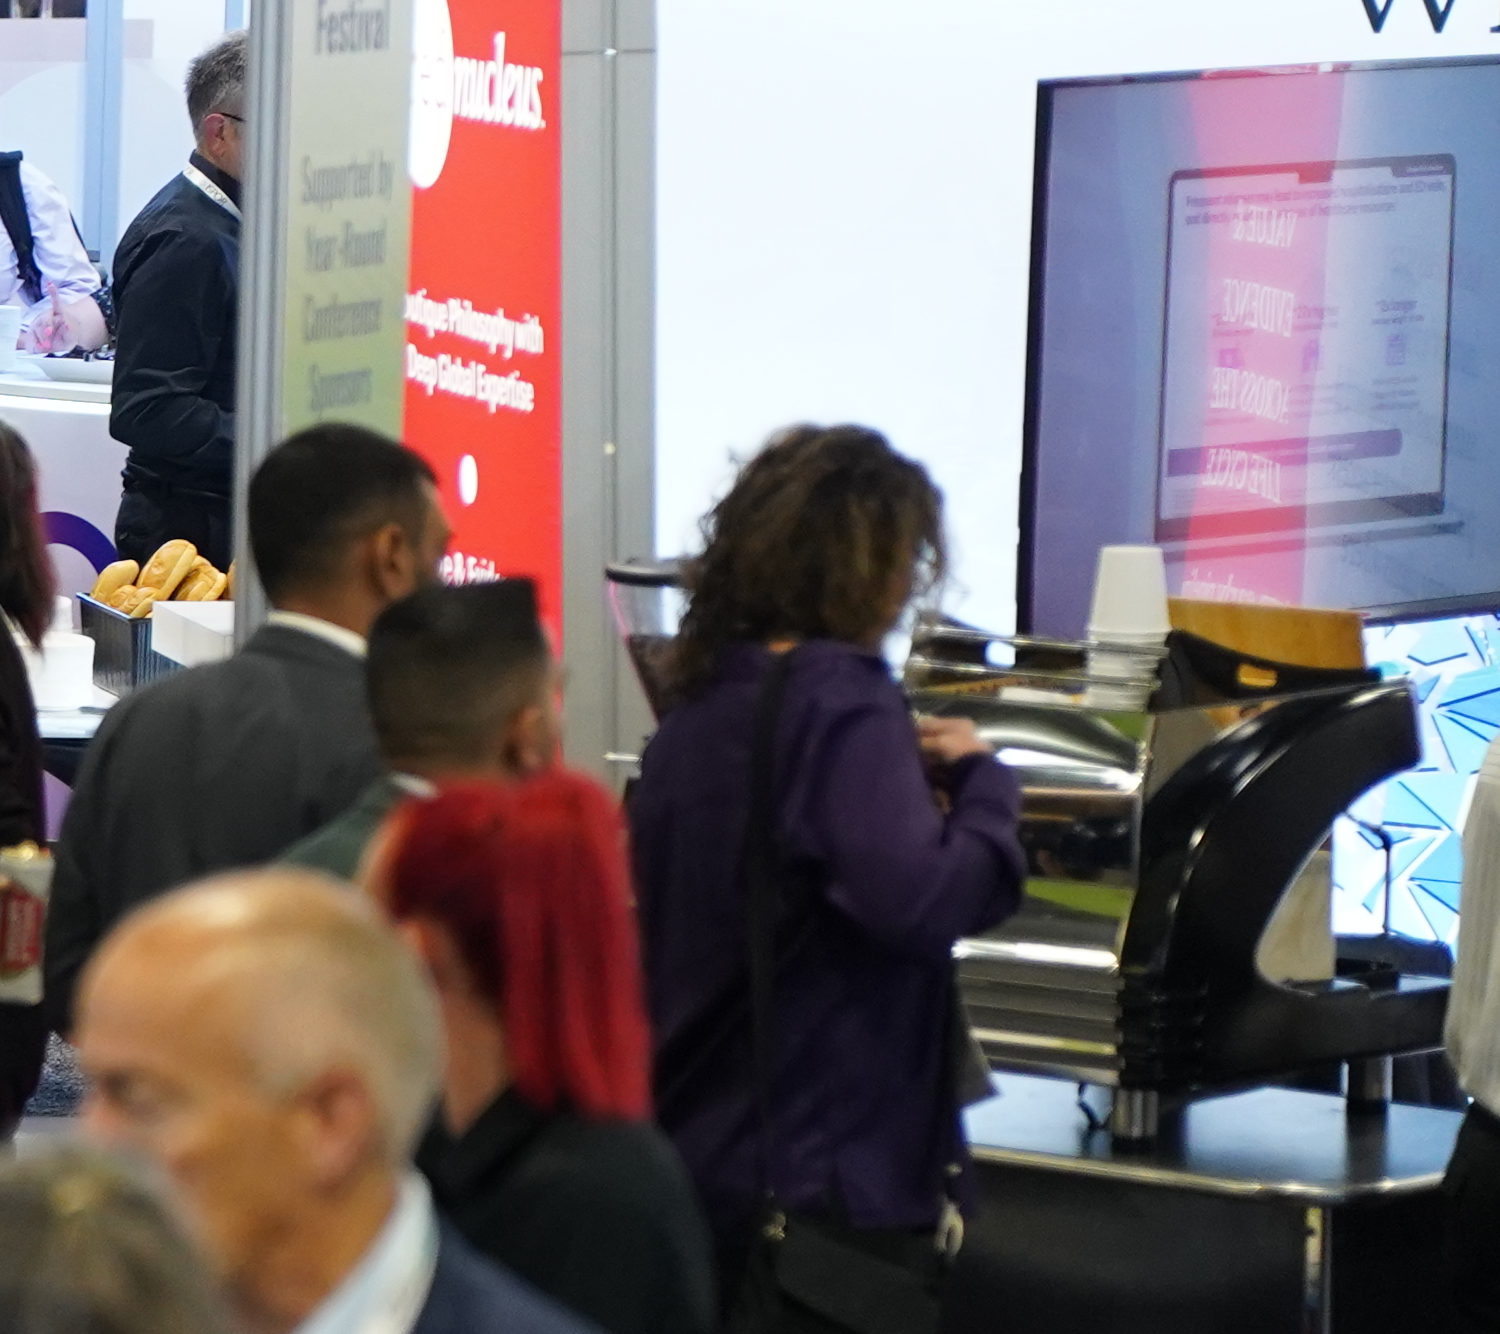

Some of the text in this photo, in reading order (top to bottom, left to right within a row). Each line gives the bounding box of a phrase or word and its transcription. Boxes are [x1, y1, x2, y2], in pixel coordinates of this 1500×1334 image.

[448, 298, 514, 359] Philosophy
[514, 313, 544, 354] with
[407, 343, 534, 414] Deep Global Expertise
